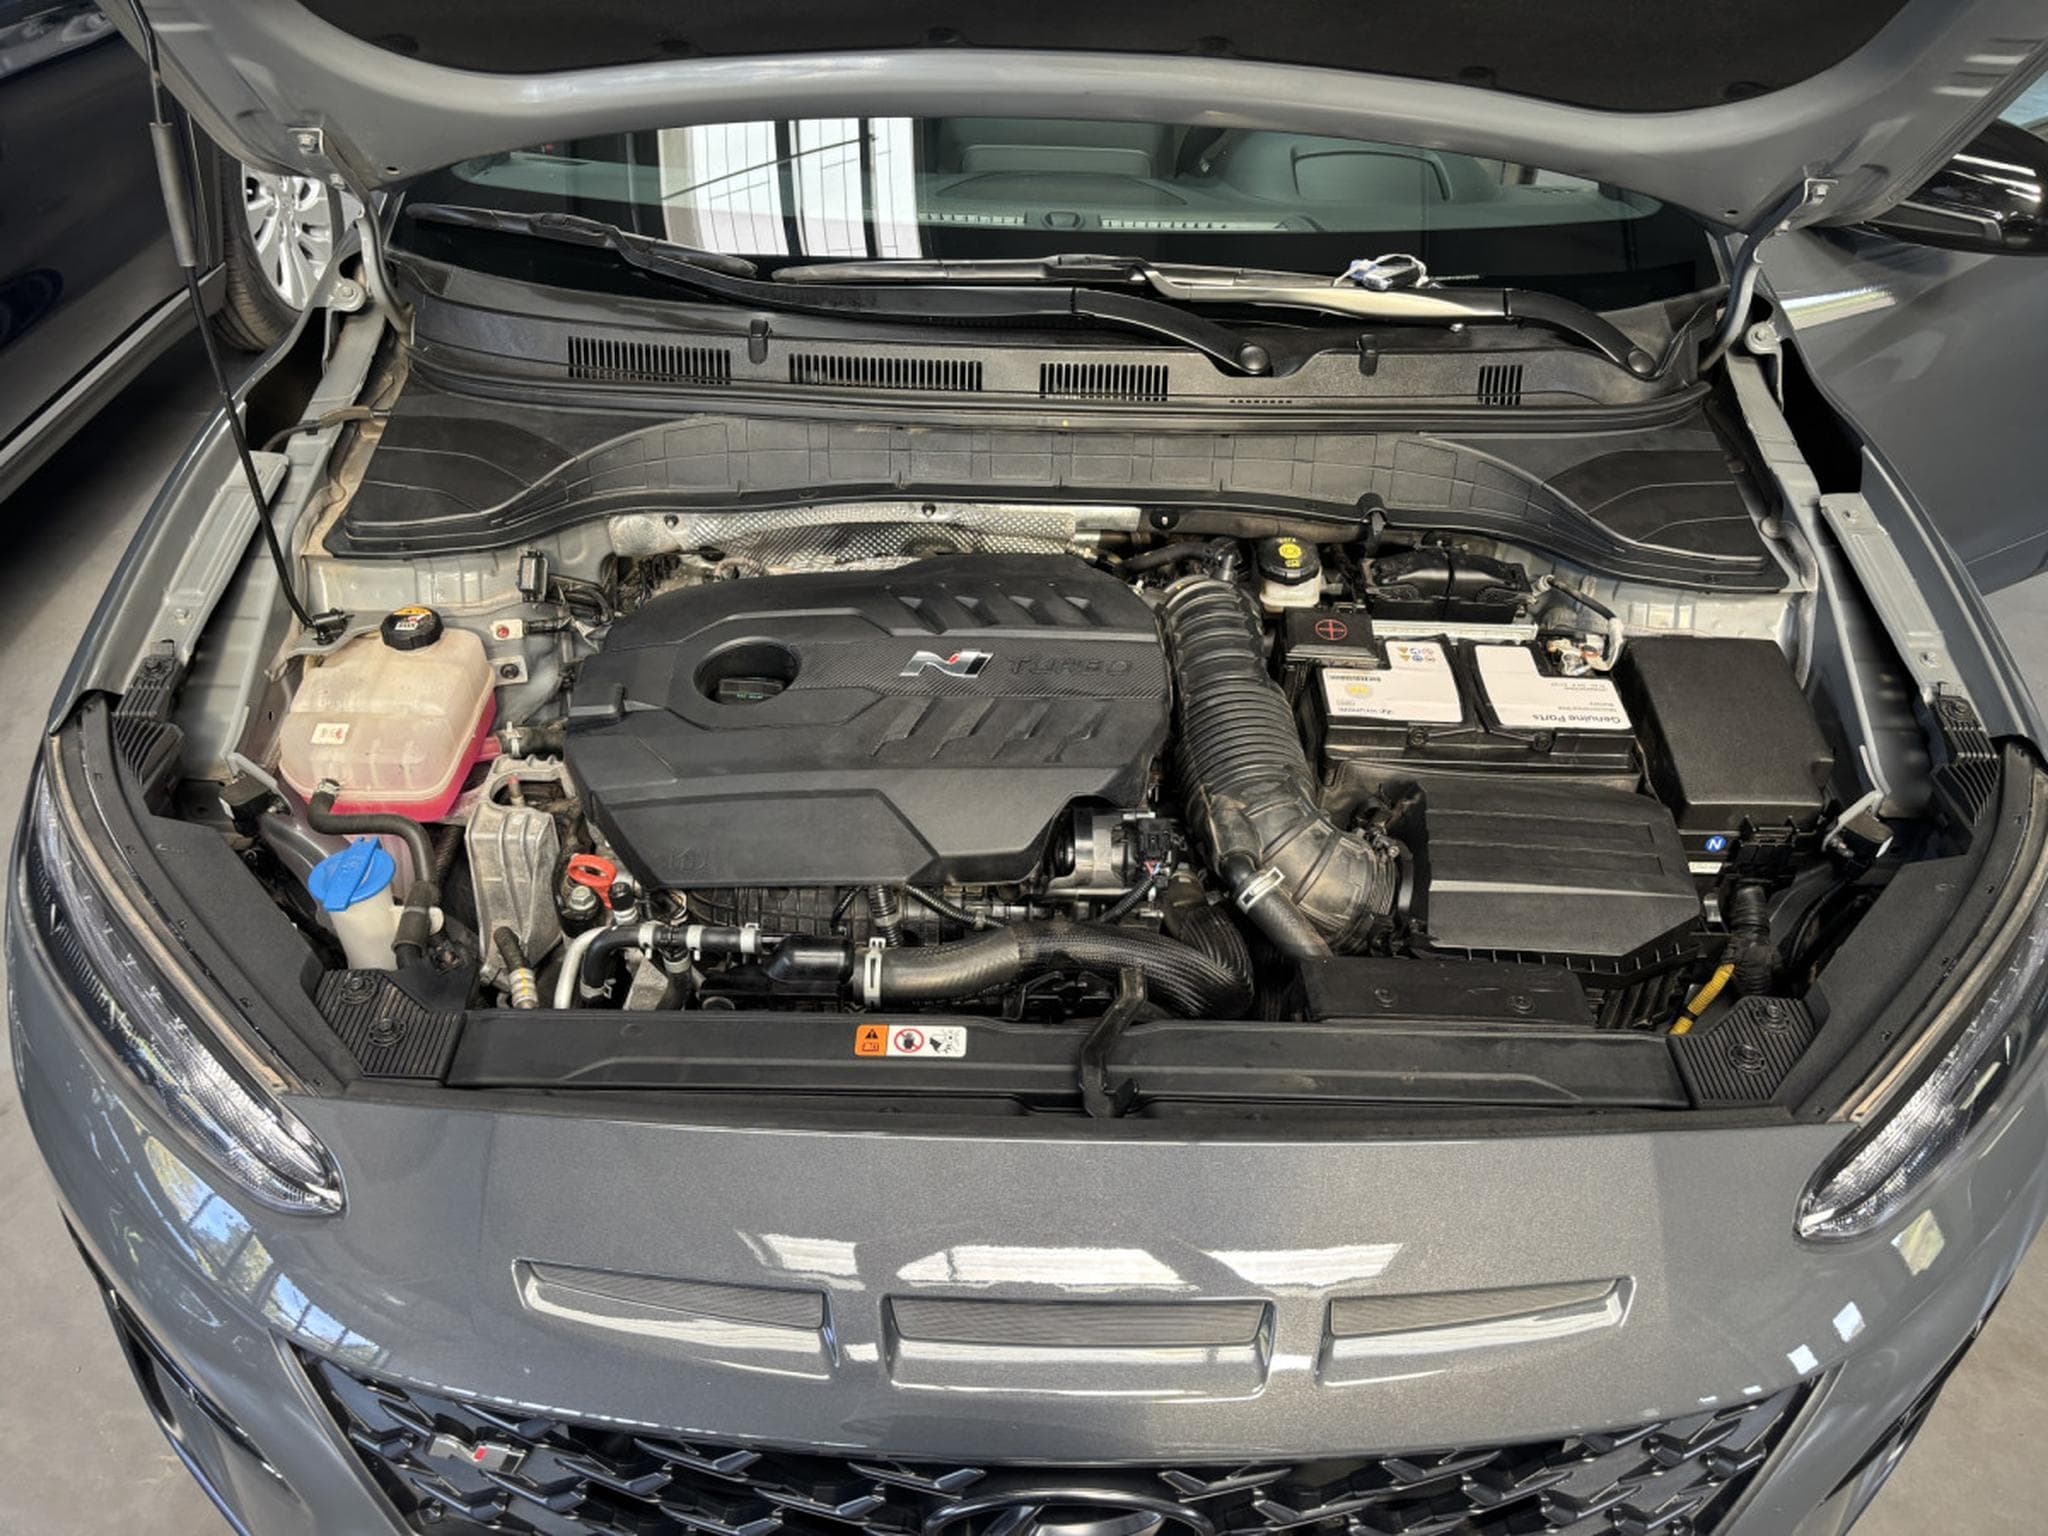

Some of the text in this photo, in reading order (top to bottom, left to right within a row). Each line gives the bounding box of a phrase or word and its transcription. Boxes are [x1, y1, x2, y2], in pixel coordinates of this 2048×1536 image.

[1009, 656, 1133, 675] TURBO
[1532, 714, 1621, 725] Genuine Parts
